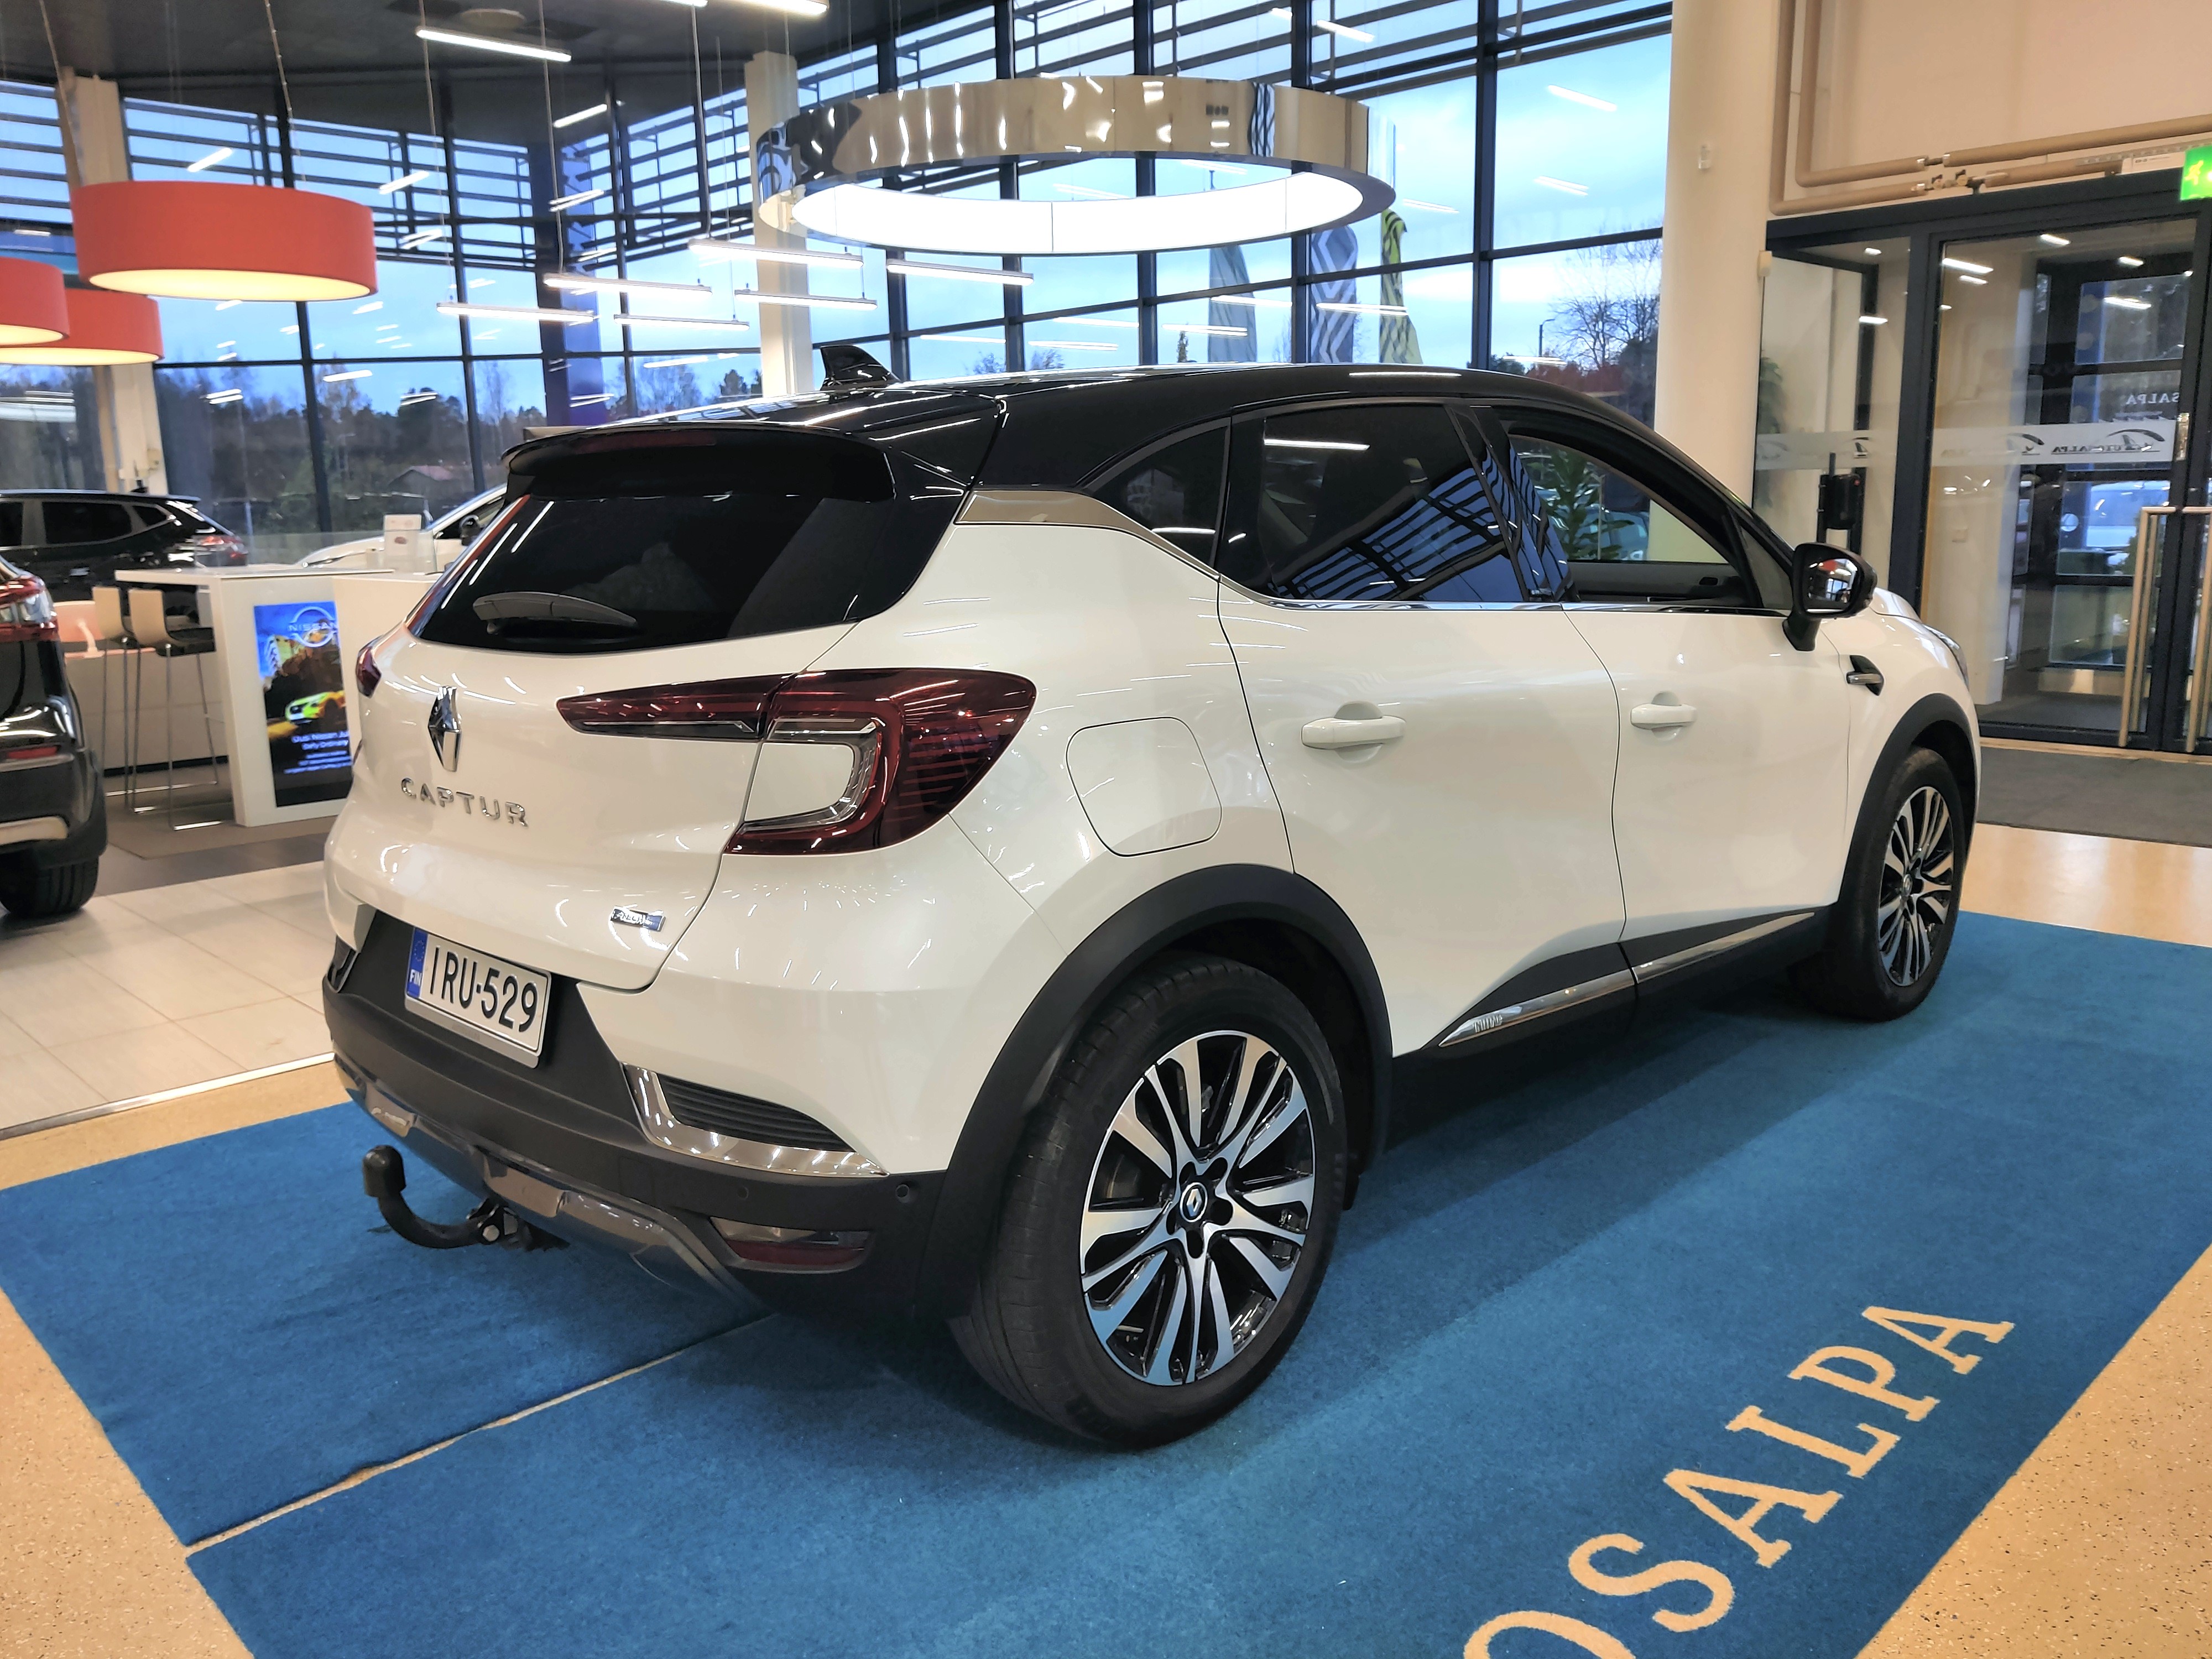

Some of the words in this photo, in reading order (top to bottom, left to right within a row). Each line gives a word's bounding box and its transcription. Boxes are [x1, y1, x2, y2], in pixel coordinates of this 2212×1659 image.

[401, 777, 529, 827] CAPTUR
[409, 969, 422, 987] FIN
[430, 946, 538, 1032] IRU-529
